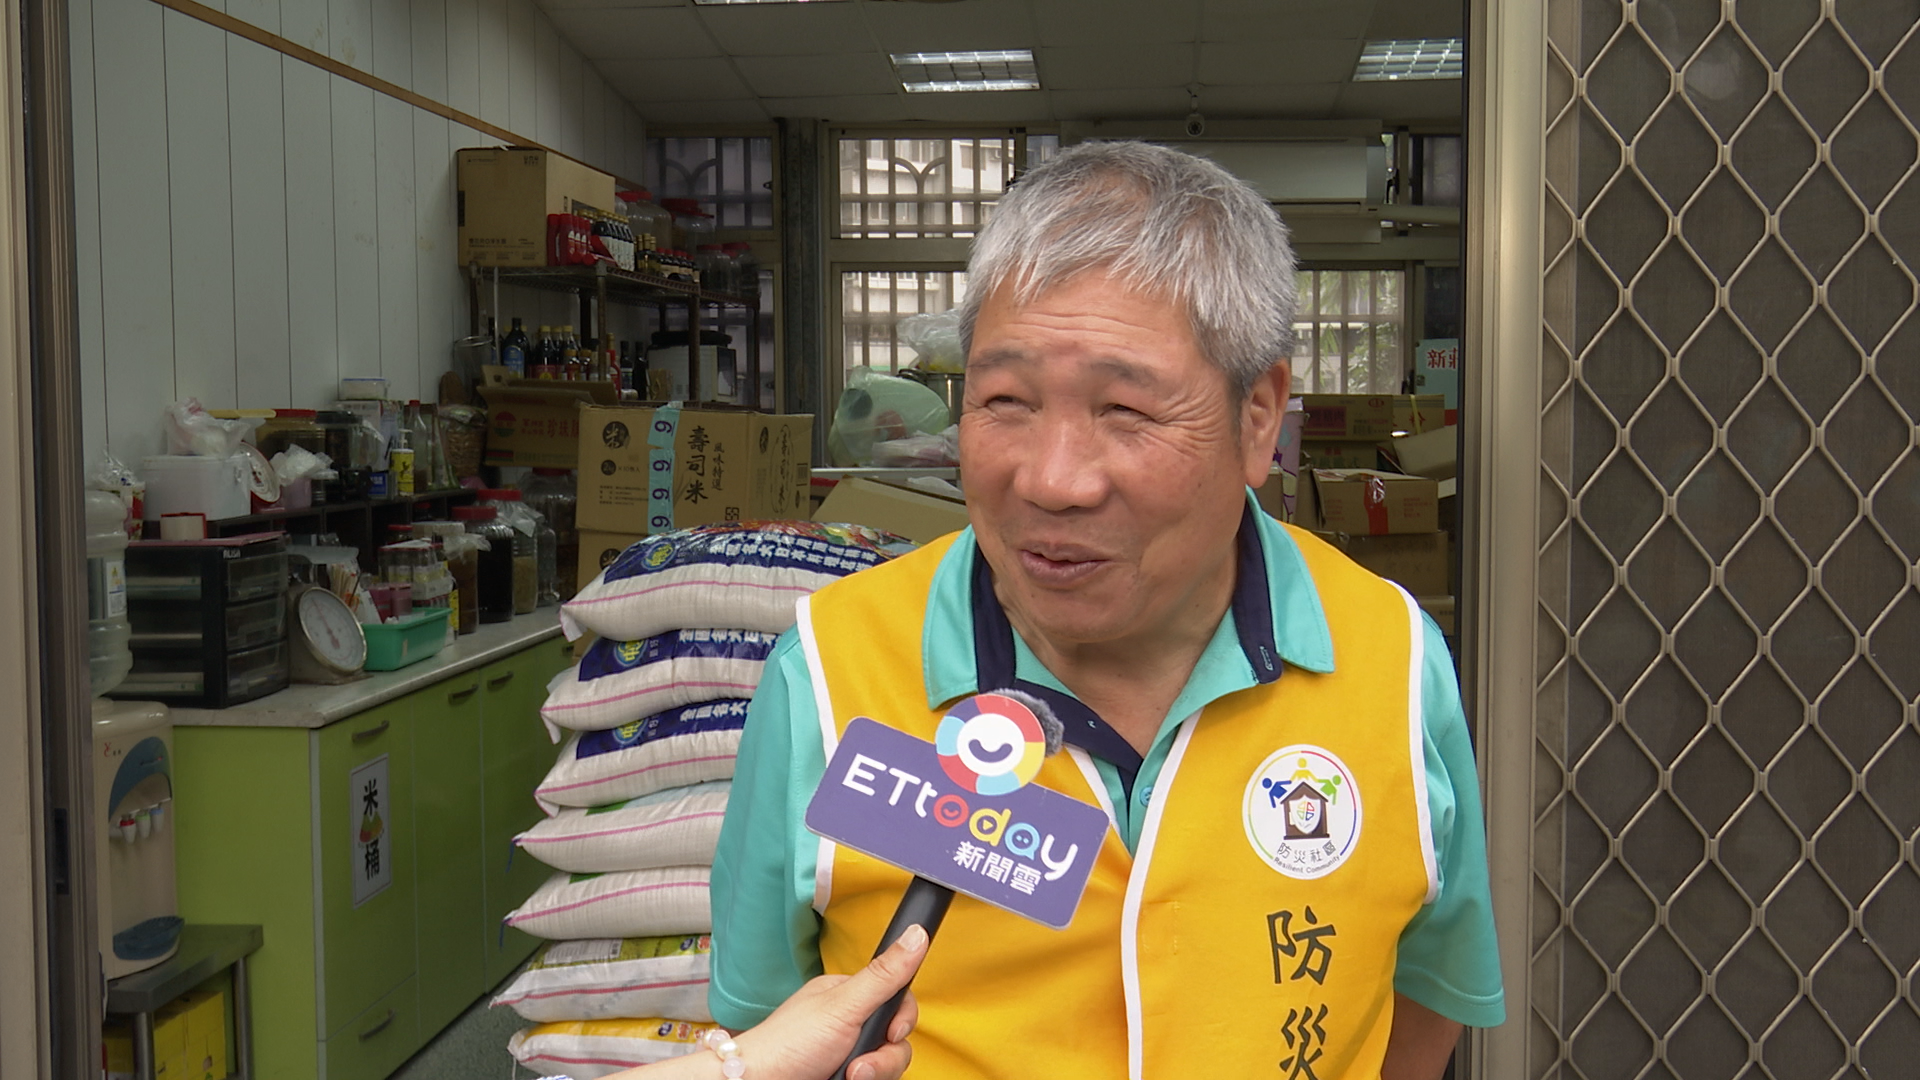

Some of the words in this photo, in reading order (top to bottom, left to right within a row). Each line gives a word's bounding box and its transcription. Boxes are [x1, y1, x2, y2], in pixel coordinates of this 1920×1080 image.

[684, 425, 710, 505] 壽司米
[363, 778, 380, 881] 米桶
[842, 753, 1078, 881] ETtoday
[1277, 840, 1337, 865] 防災社區
[952, 840, 1042, 896] 新聞雲
[1273, 857, 1304, 873] Resilient
[1305, 854, 1341, 874] Community
[1266, 905, 1337, 1080] 防災
